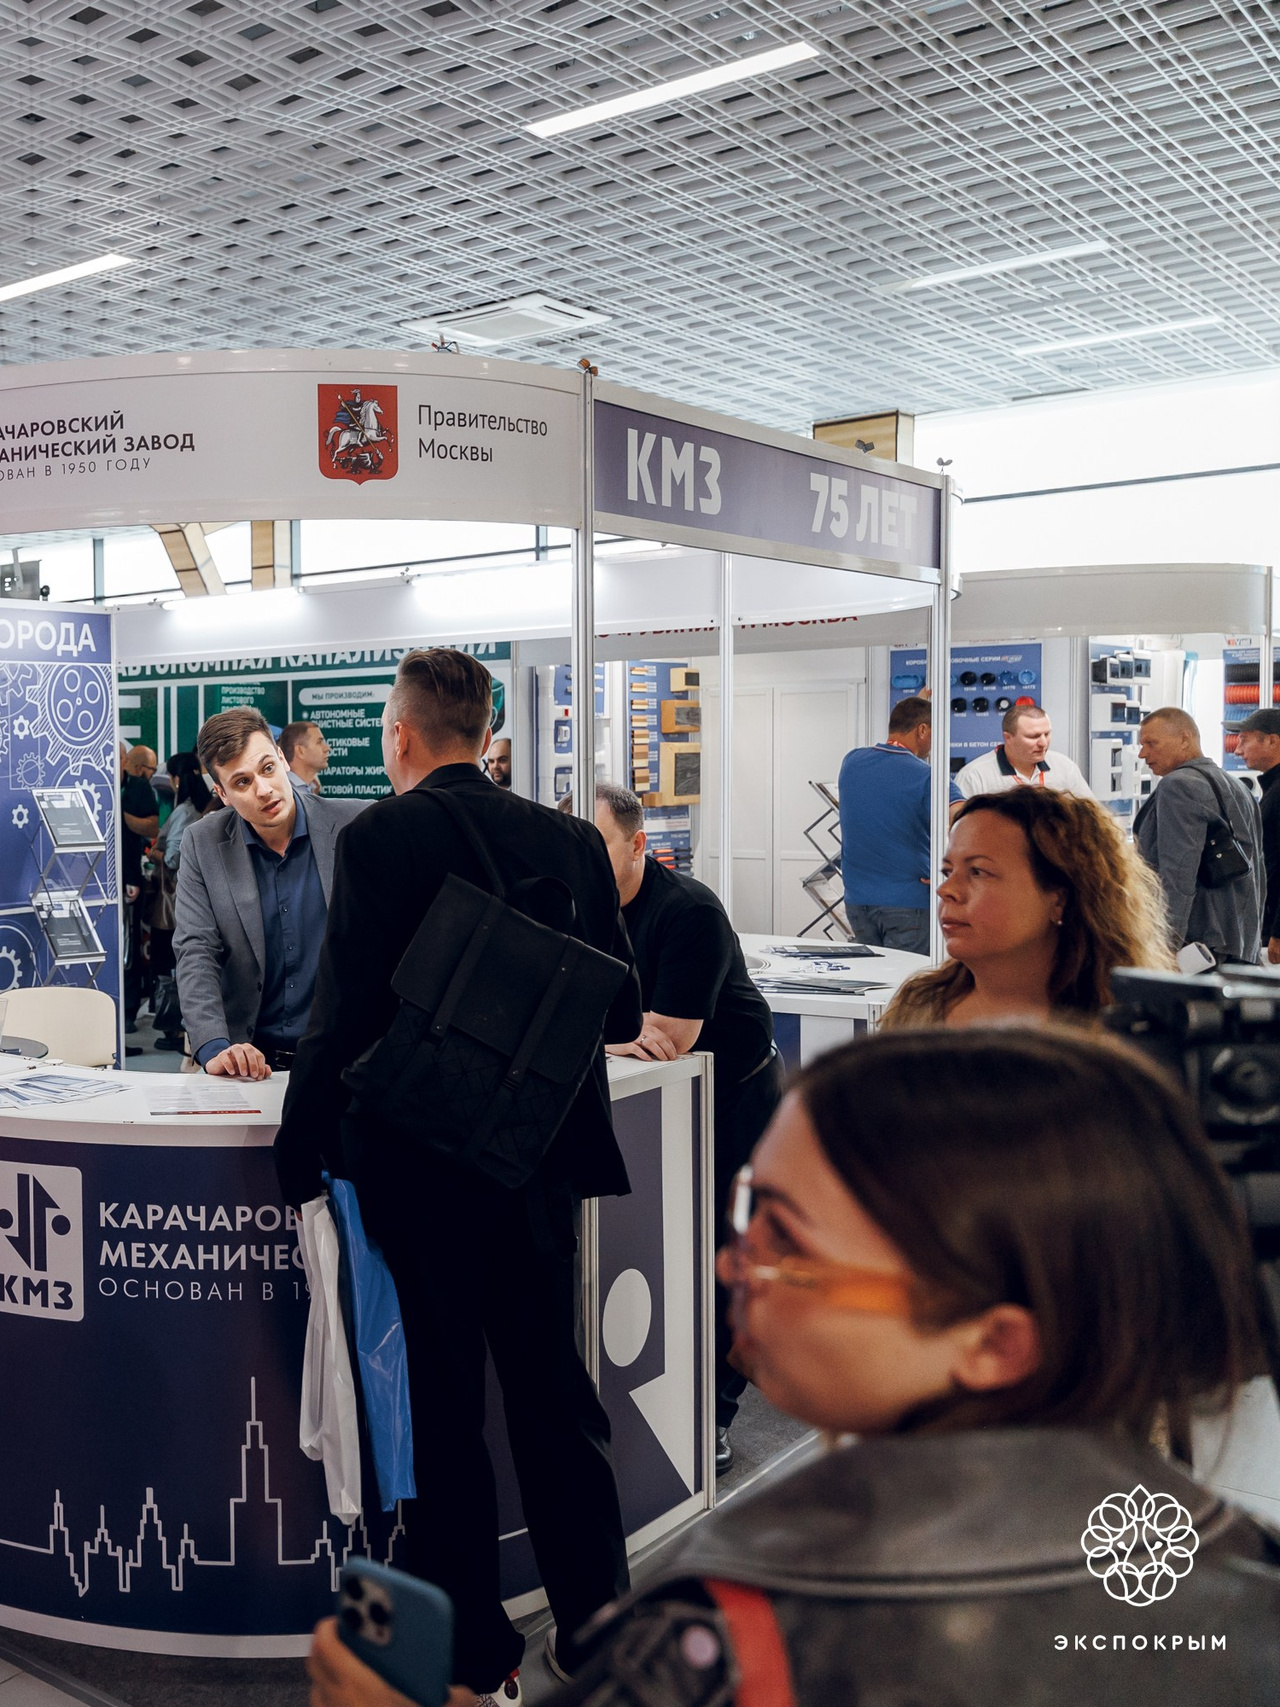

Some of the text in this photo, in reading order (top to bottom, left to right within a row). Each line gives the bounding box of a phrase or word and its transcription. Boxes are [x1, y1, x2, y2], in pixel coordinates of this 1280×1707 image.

[418, 404, 549, 437] Правительство
[123, 433, 196, 452] ЗАВОД
[419, 438, 494, 464] Москвы
[45, 465, 52, 477] В
[62, 461, 97, 476] 1950
[106, 457, 151, 473] ГОДУ
[627, 427, 918, 550] КМЗ 75 ЛЕТ
[310, 709, 366, 720] АВТОНОМНЫЕ
[355, 717, 383, 728] СИСТЕ
[319, 766, 364, 776] ПАРАТОРЫ
[99, 1276, 244, 1301] ОСНОВАН
[263, 1282, 274, 1300] В
